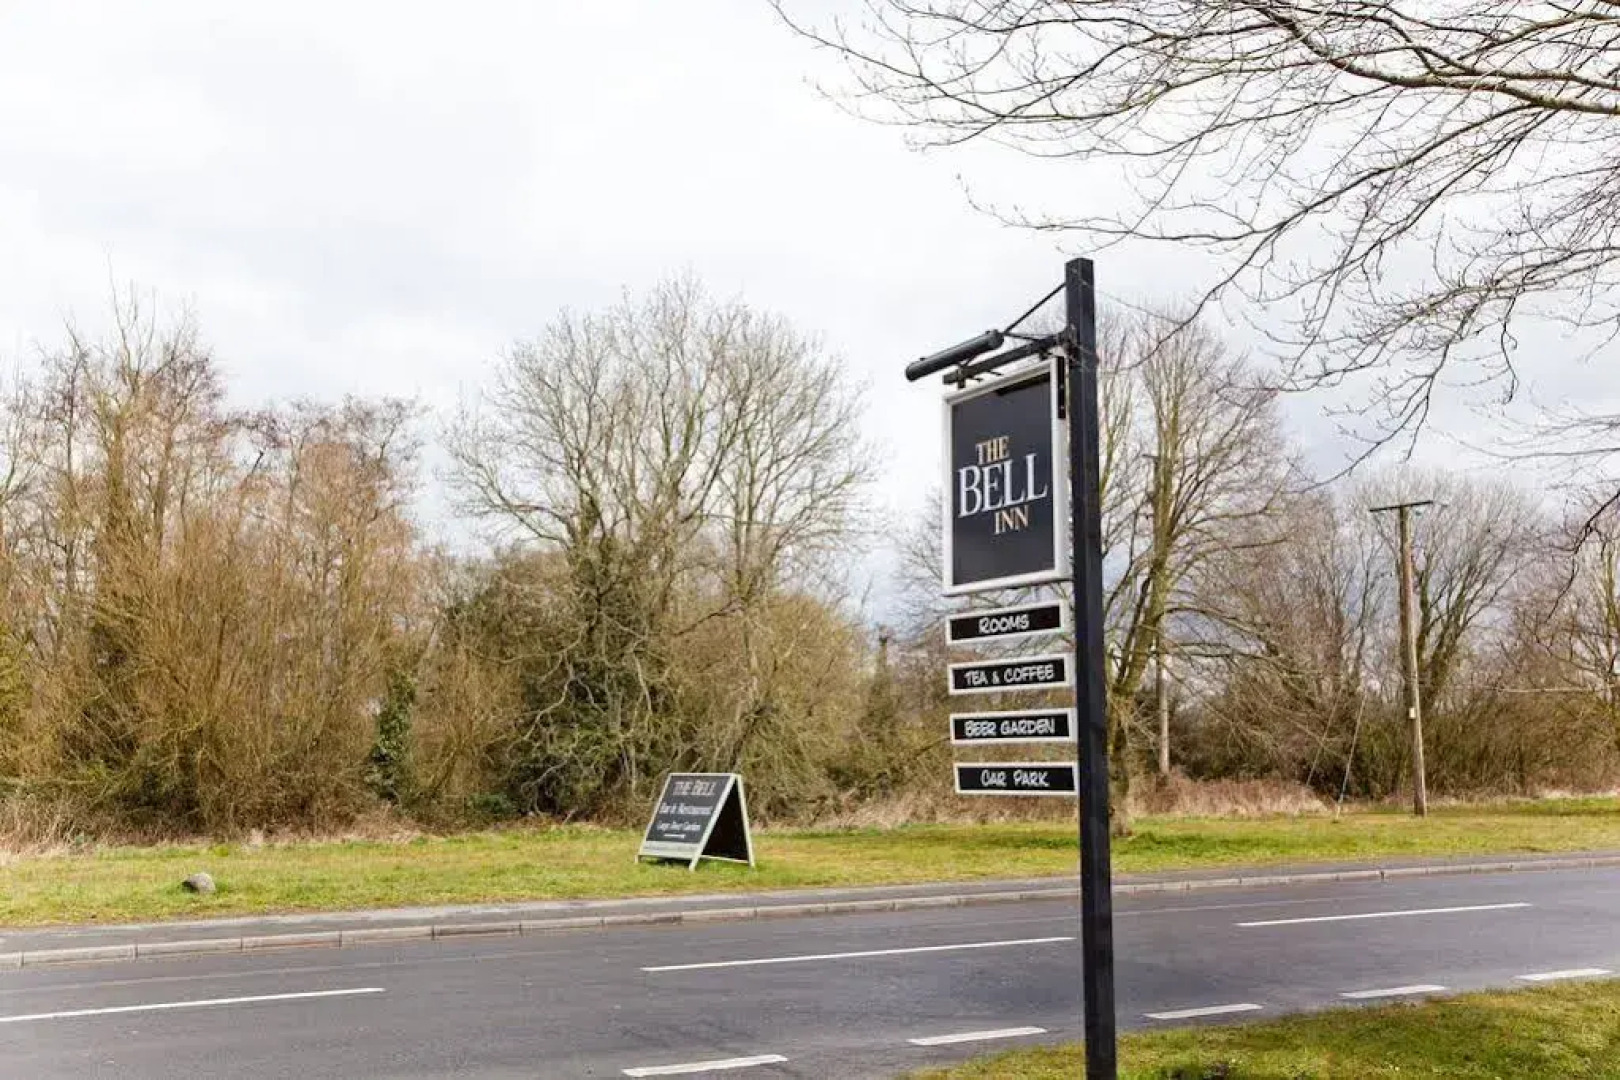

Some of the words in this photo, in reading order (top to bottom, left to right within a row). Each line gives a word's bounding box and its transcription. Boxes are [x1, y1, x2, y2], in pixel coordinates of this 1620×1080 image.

[976, 435, 1009, 464] THE
[958, 453, 1048, 518] BELL
[994, 504, 1028, 534] INN
[978, 614, 1030, 634] ROOMS
[964, 670, 989, 686] TEA
[992, 671, 1000, 684] &
[1003, 665, 1055, 683] COFFEE
[964, 720, 997, 737] BEER
[1000, 718, 1056, 735] GARDEN
[672, 781, 693, 796] THE
[692, 780, 717, 796] BELL
[980, 769, 1007, 787] CAR
[1013, 769, 1050, 787] PARK
